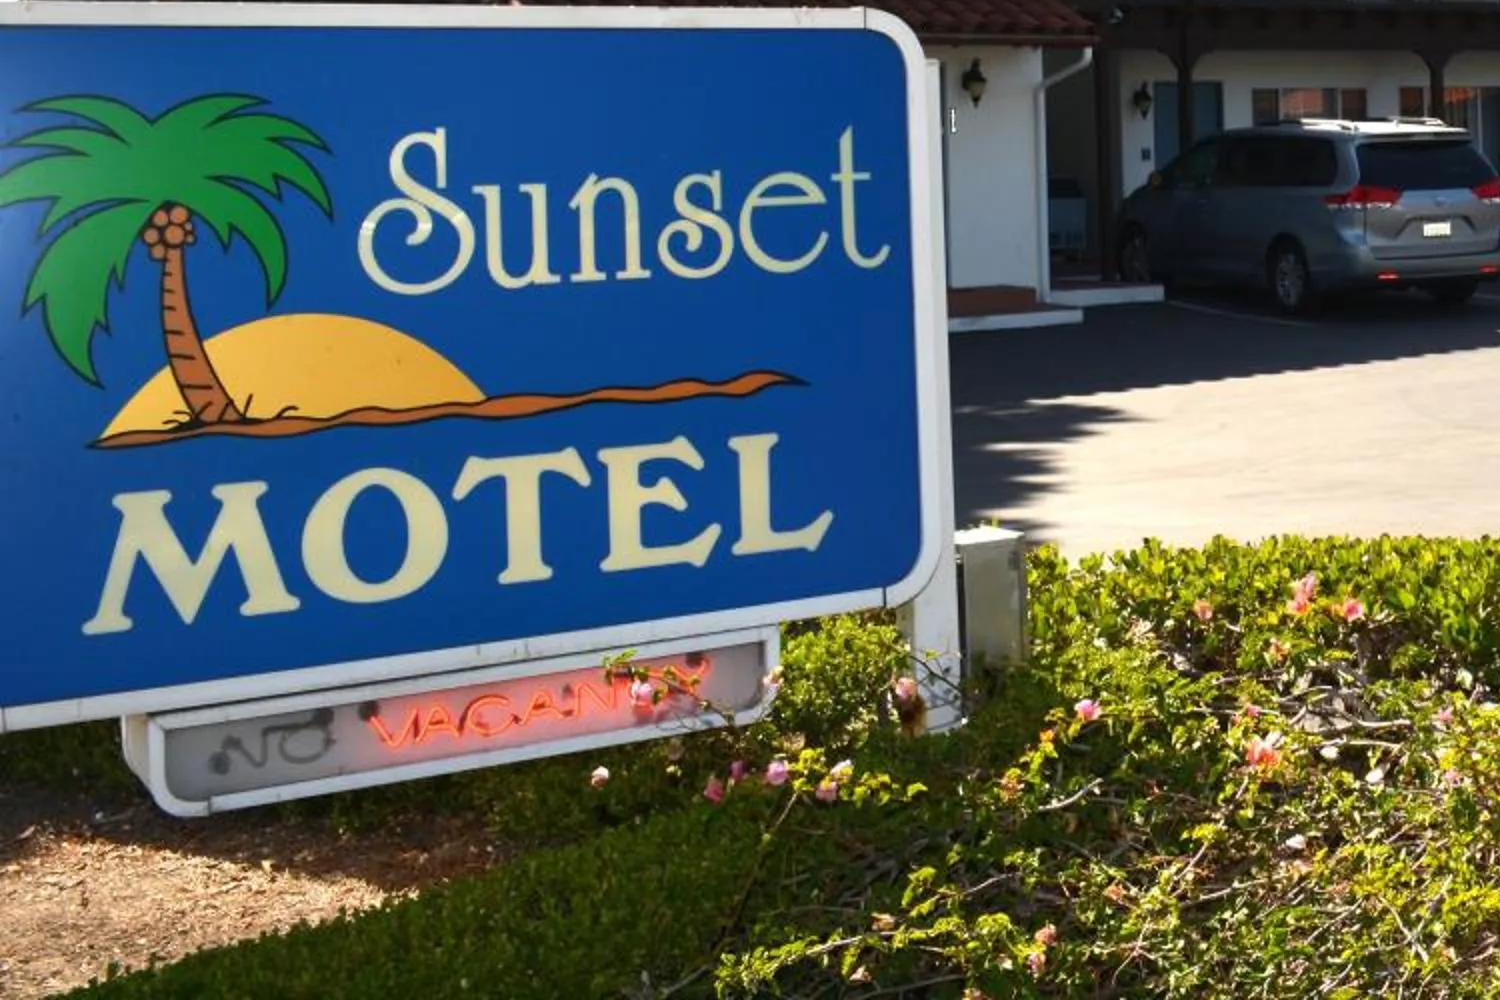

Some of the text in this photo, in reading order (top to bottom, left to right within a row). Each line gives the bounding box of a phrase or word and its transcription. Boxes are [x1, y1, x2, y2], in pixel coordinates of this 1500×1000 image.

[356, 125, 891, 296] Sunset
[81, 431, 835, 636] MOTEL
[208, 707, 330, 772] NO
